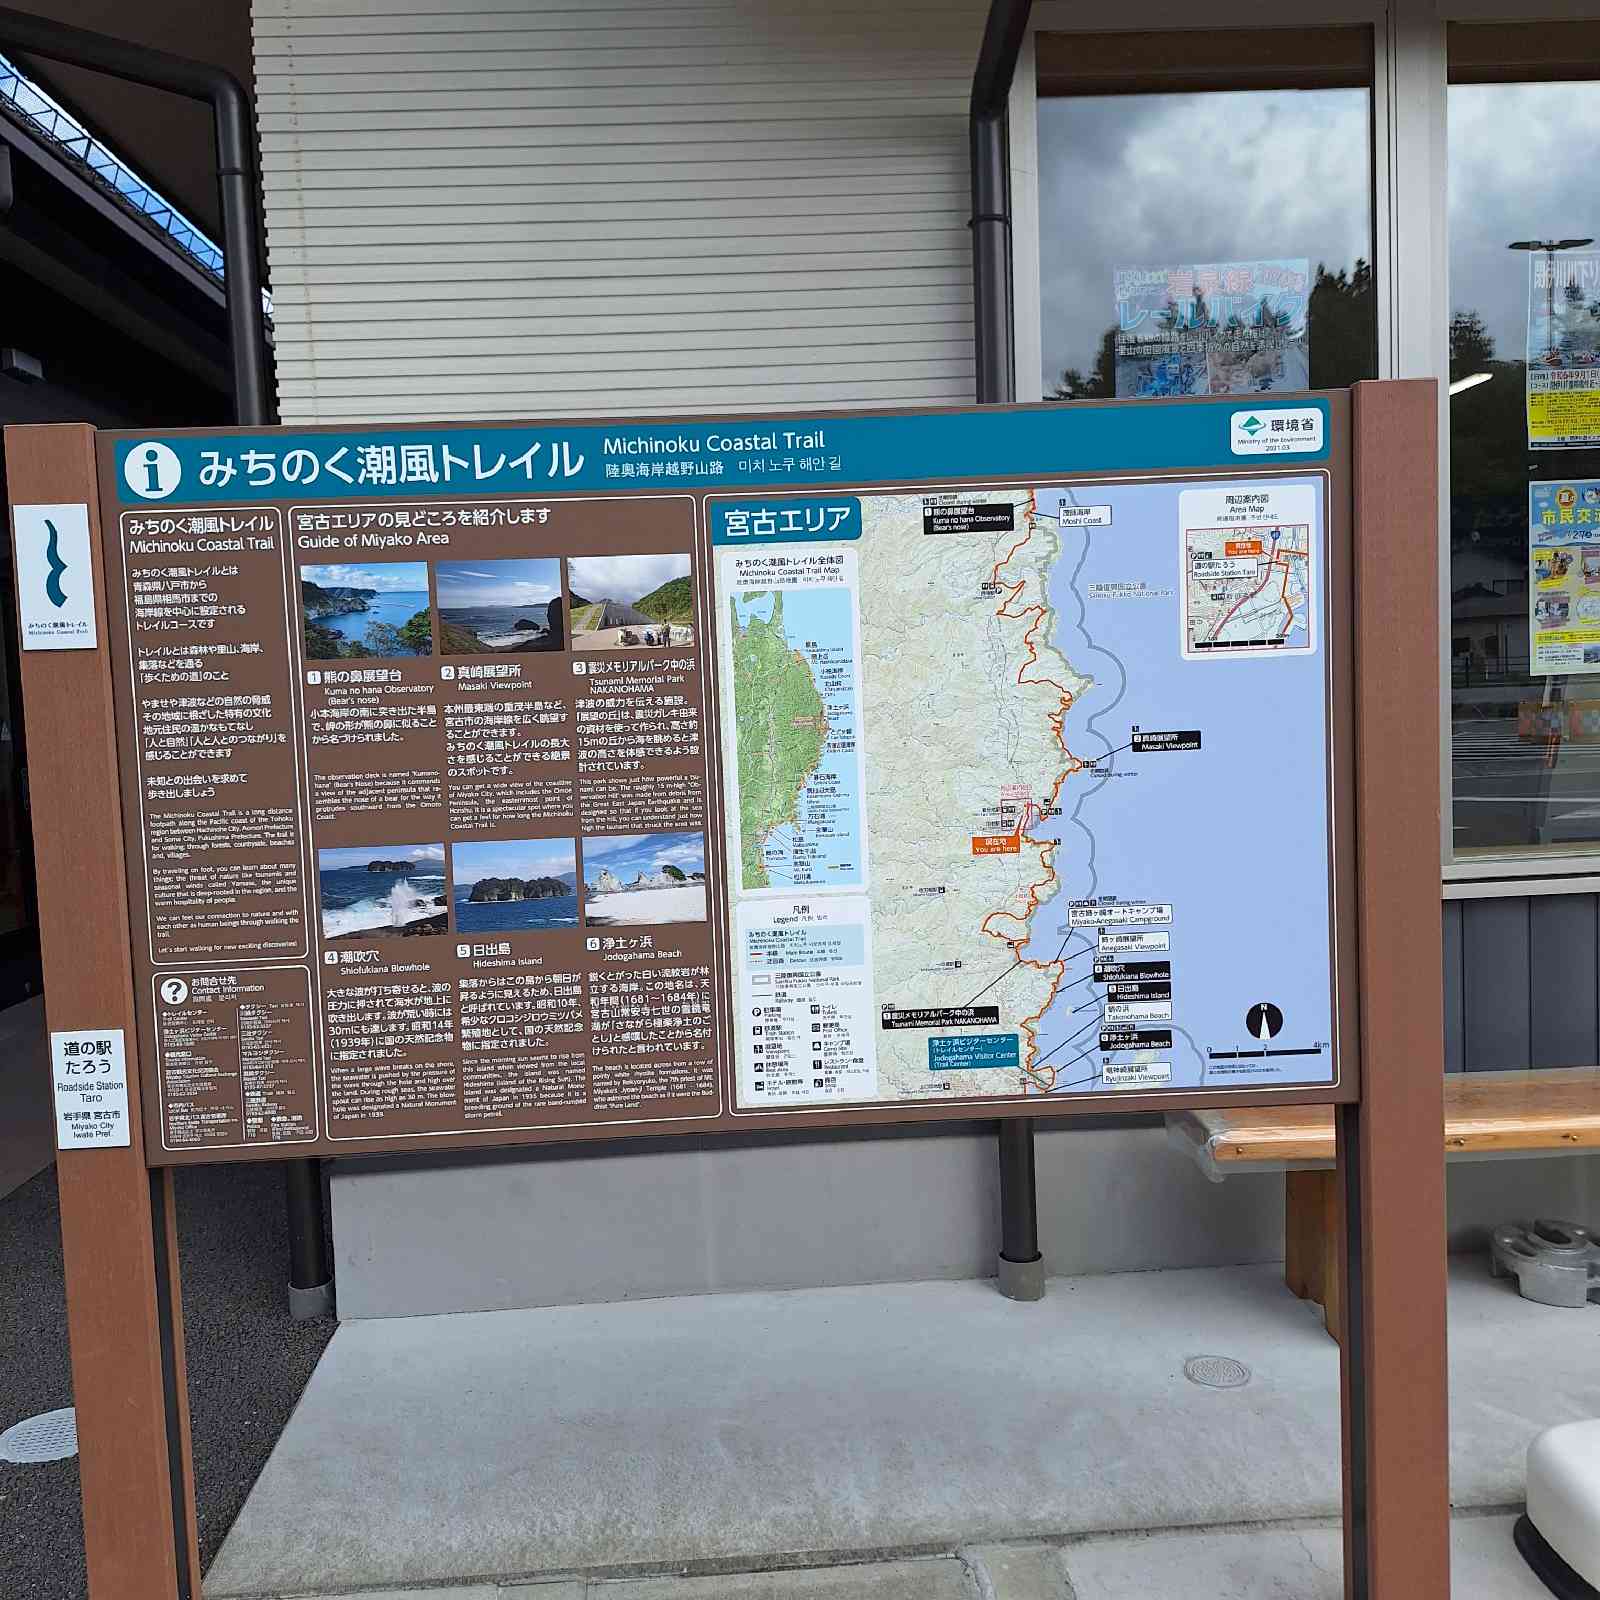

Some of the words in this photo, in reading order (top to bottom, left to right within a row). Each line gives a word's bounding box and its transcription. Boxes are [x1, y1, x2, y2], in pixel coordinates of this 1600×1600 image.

[1120, 295, 1302, 330] レールバイク
[1271, 419, 1314, 432] 環境省
[604, 435, 700, 455] Michinoku
[707, 432, 777, 451] Coastal
[783, 431, 824, 449] Trail
[200, 443, 584, 487] みちのく潮風トレイル
[605, 460, 724, 478] 陸奥海岸越野山路
[800, 456, 825, 470] 해안
[829, 456, 841, 470] 길
[130, 515, 274, 535] みちのく潮風トレイル
[297, 508, 551, 530] 宮古エリアの見どころを紹介します
[725, 507, 850, 537] 宮古エリア
[130, 539, 193, 553] Michinoku
[197, 538, 243, 551] Coastal
[249, 536, 274, 550] Trail
[297, 534, 338, 550] Guide
[344, 533, 357, 547] of
[361, 532, 413, 549] Miyako
[416, 530, 450, 546] Area
[740, 568, 775, 576] Michinoku
[778, 567, 805, 575] Coastal
[137, 619, 215, 631] トレイルコースです
[324, 669, 401, 684] 熊の鼻展望台
[458, 665, 520, 679] 真崎展望所
[458, 683, 487, 691] Masaki
[490, 681, 533, 690] Viewpoint
[590, 677, 623, 686] Tsunami
[626, 676, 664, 684] Memorial
[363, 686, 382, 694] hana
[384, 685, 434, 693] Observatory
[590, 685, 654, 694] NAKANOHAMA
[328, 697, 355, 706] (Bear's
[357, 696, 379, 704] nose)
[148, 787, 215, 799] 歩き出しましょう
[793, 905, 809, 914] 凡例
[773, 916, 798, 924] Legend
[474, 943, 510, 956] 日出島
[603, 952, 655, 961] Jodogahama
[658, 950, 682, 958] Beach
[340, 950, 379, 963] 潮吹穴
[473, 960, 515, 968] Hideshima
[518, 957, 543, 965] Island
[391, 963, 430, 972] Blowhole
[192, 976, 237, 986] お問合せ先
[192, 987, 220, 995] Contact
[223, 985, 264, 993] Information
[64, 1041, 112, 1056] 道の駅
[66, 1060, 111, 1074] たろう
[58, 1083, 94, 1092] Roadside
[96, 1081, 123, 1090] Station
[80, 1094, 102, 1102] Taro
[64, 1112, 91, 1120] 岩手県
[94, 1111, 120, 1119] 宮古市
